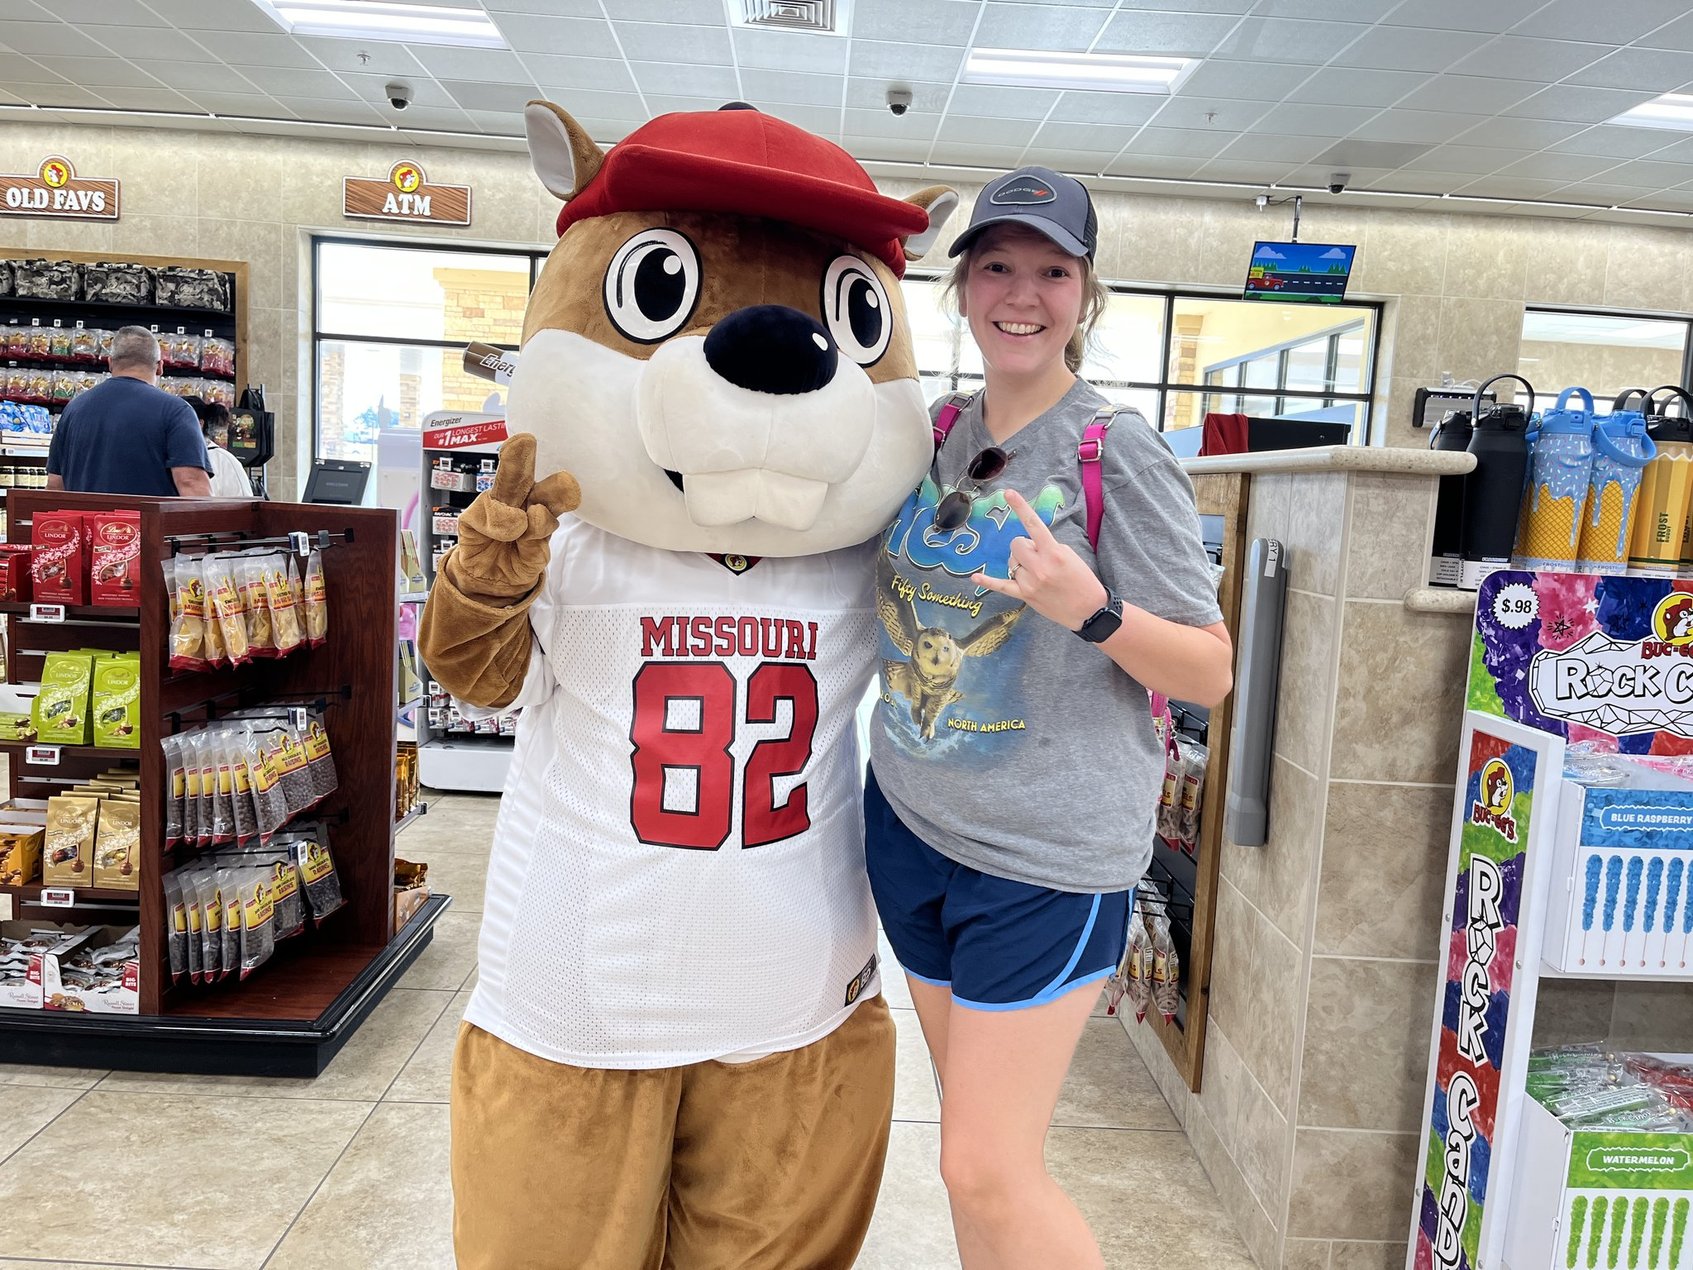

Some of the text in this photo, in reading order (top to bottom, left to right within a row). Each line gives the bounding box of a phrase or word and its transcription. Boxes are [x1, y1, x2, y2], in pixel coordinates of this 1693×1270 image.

[6, 187, 105, 212] OLD FAVS
[382, 192, 432, 216] ATM
[430, 416, 462, 428] Energizer
[452, 426, 483, 436] LONGEST
[450, 434, 478, 445] MAX
[1656, 512, 1668, 542] FROST
[892, 574, 983, 617] Fifty Something
[1501, 598, 1532, 614] $.98
[640, 616, 818, 660] MISSOURI
[948, 718, 1026, 732] NORTH AMERICA
[629, 661, 819, 852] 82
[1611, 813, 1692, 824] BLUE RASPBERRY
[312, 862, 329, 874] RAISINS
[1602, 1155, 1675, 1165] WATERMELON
